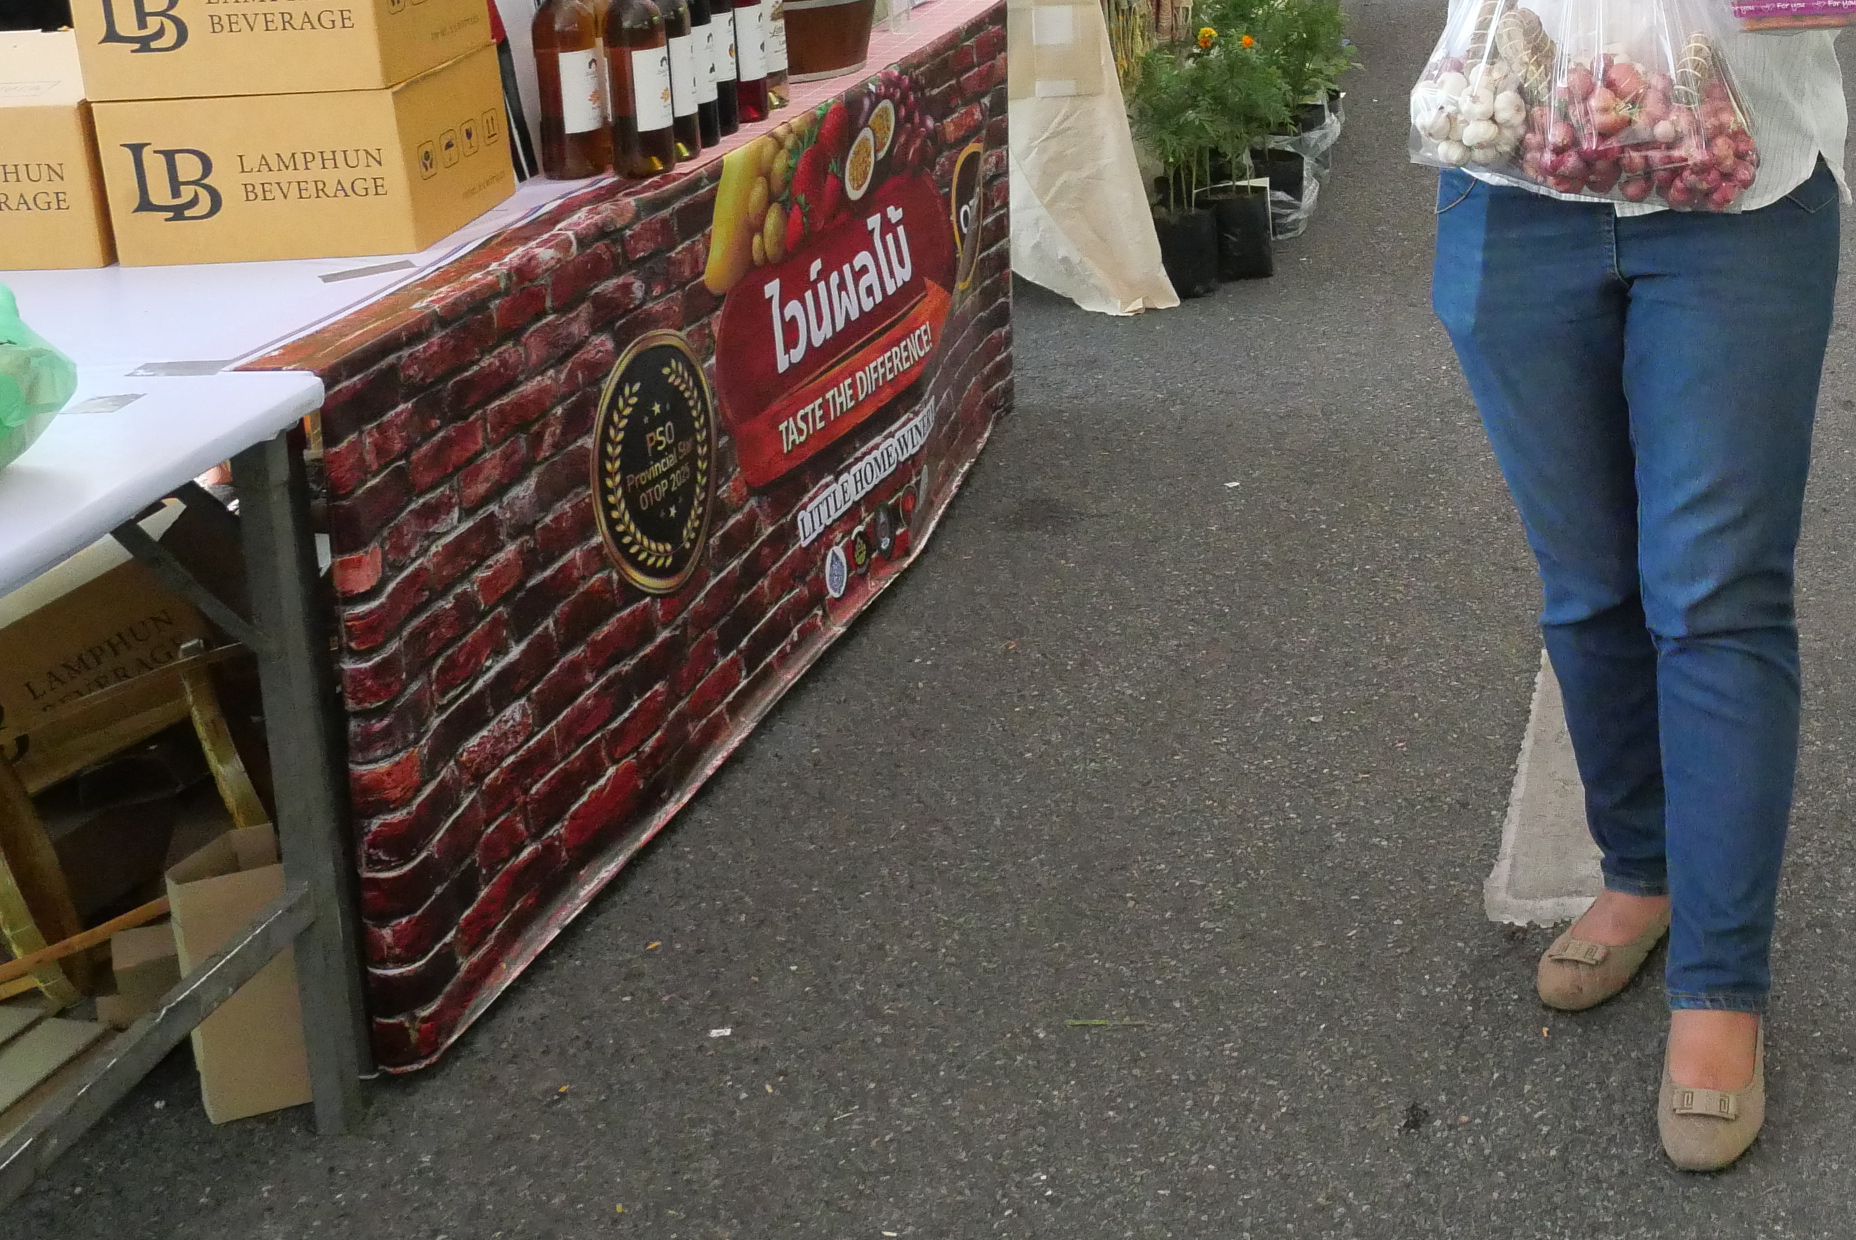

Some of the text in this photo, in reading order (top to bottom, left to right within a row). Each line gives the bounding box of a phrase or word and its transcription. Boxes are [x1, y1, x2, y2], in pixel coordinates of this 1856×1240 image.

[208, 9, 355, 34] BEVERAGE
[1791, 2, 1806, 12] you
[1828, 0, 1842, 7] For
[1843, 0, 1856, 9] you
[236, 148, 384, 174] LAMPHUN
[120, 142, 223, 222] LB
[241, 176, 388, 202] BEVERAGE
[764, 205, 913, 374] ไวน์ผลไม้
[778, 321, 933, 453] TASTE THE DIFFERENCE!
[645, 421, 675, 456] PSO
[626, 447, 678, 493] Provincial
[639, 480, 668, 510] OTOP
[800, 480, 850, 540] LITTLE
[853, 442, 896, 495] HOME
[24, 609, 174, 701] LAMPHUN
